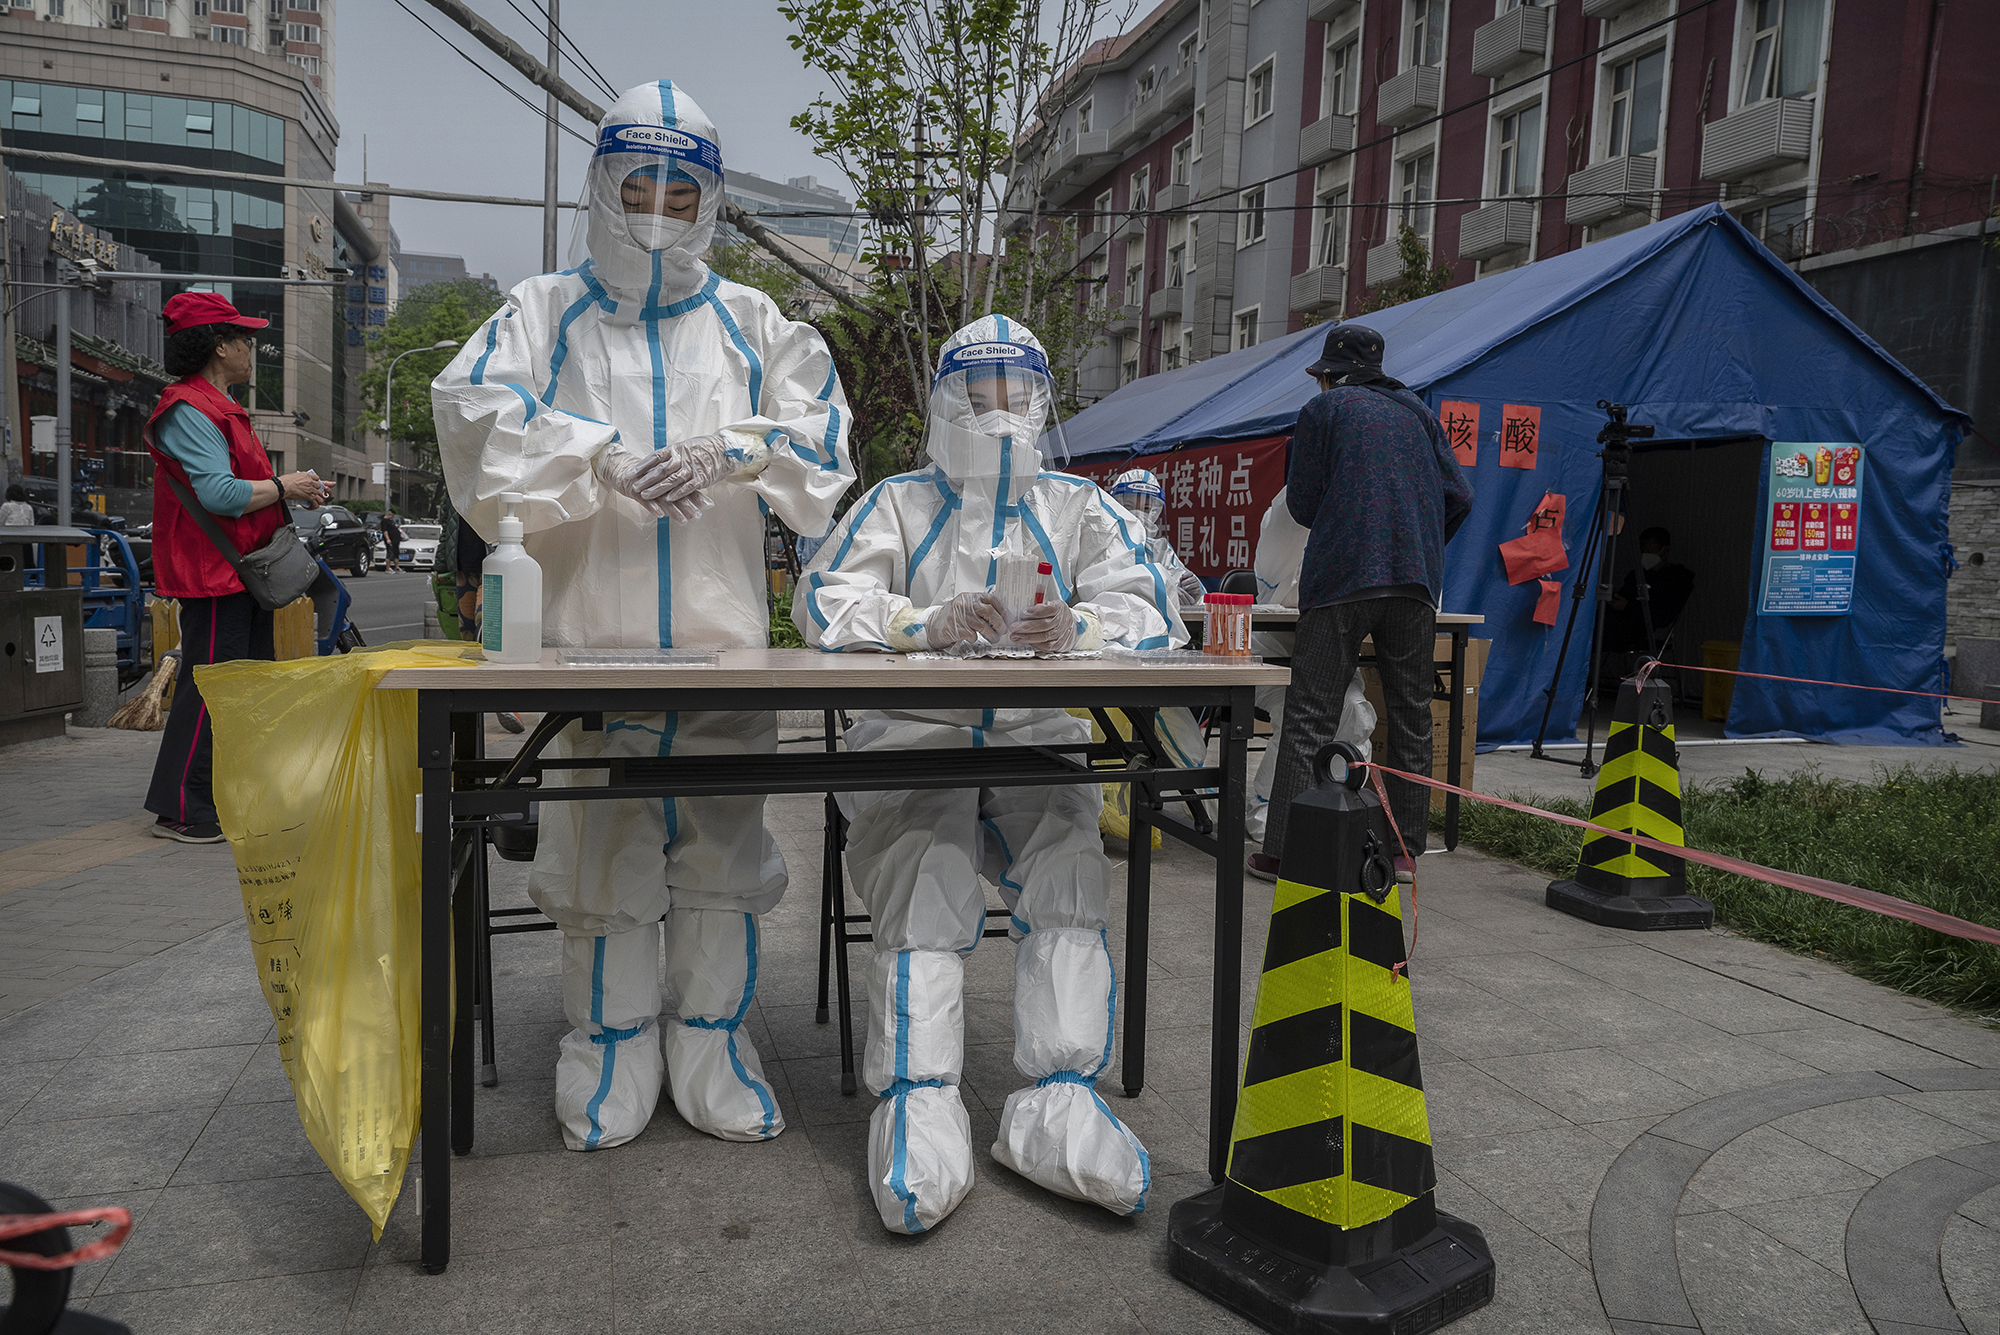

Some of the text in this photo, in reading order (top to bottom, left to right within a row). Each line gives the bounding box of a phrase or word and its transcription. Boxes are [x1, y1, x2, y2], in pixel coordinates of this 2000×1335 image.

[625, 130, 688, 147] Face Shield
[647, 145, 672, 154] Protective
[673, 149, 686, 157] Mask
[961, 346, 1016, 358] Face Shield
[1444, 411, 1536, 455] 核酸
[1776, 487, 1858, 499] 60岁以上老年人接种
